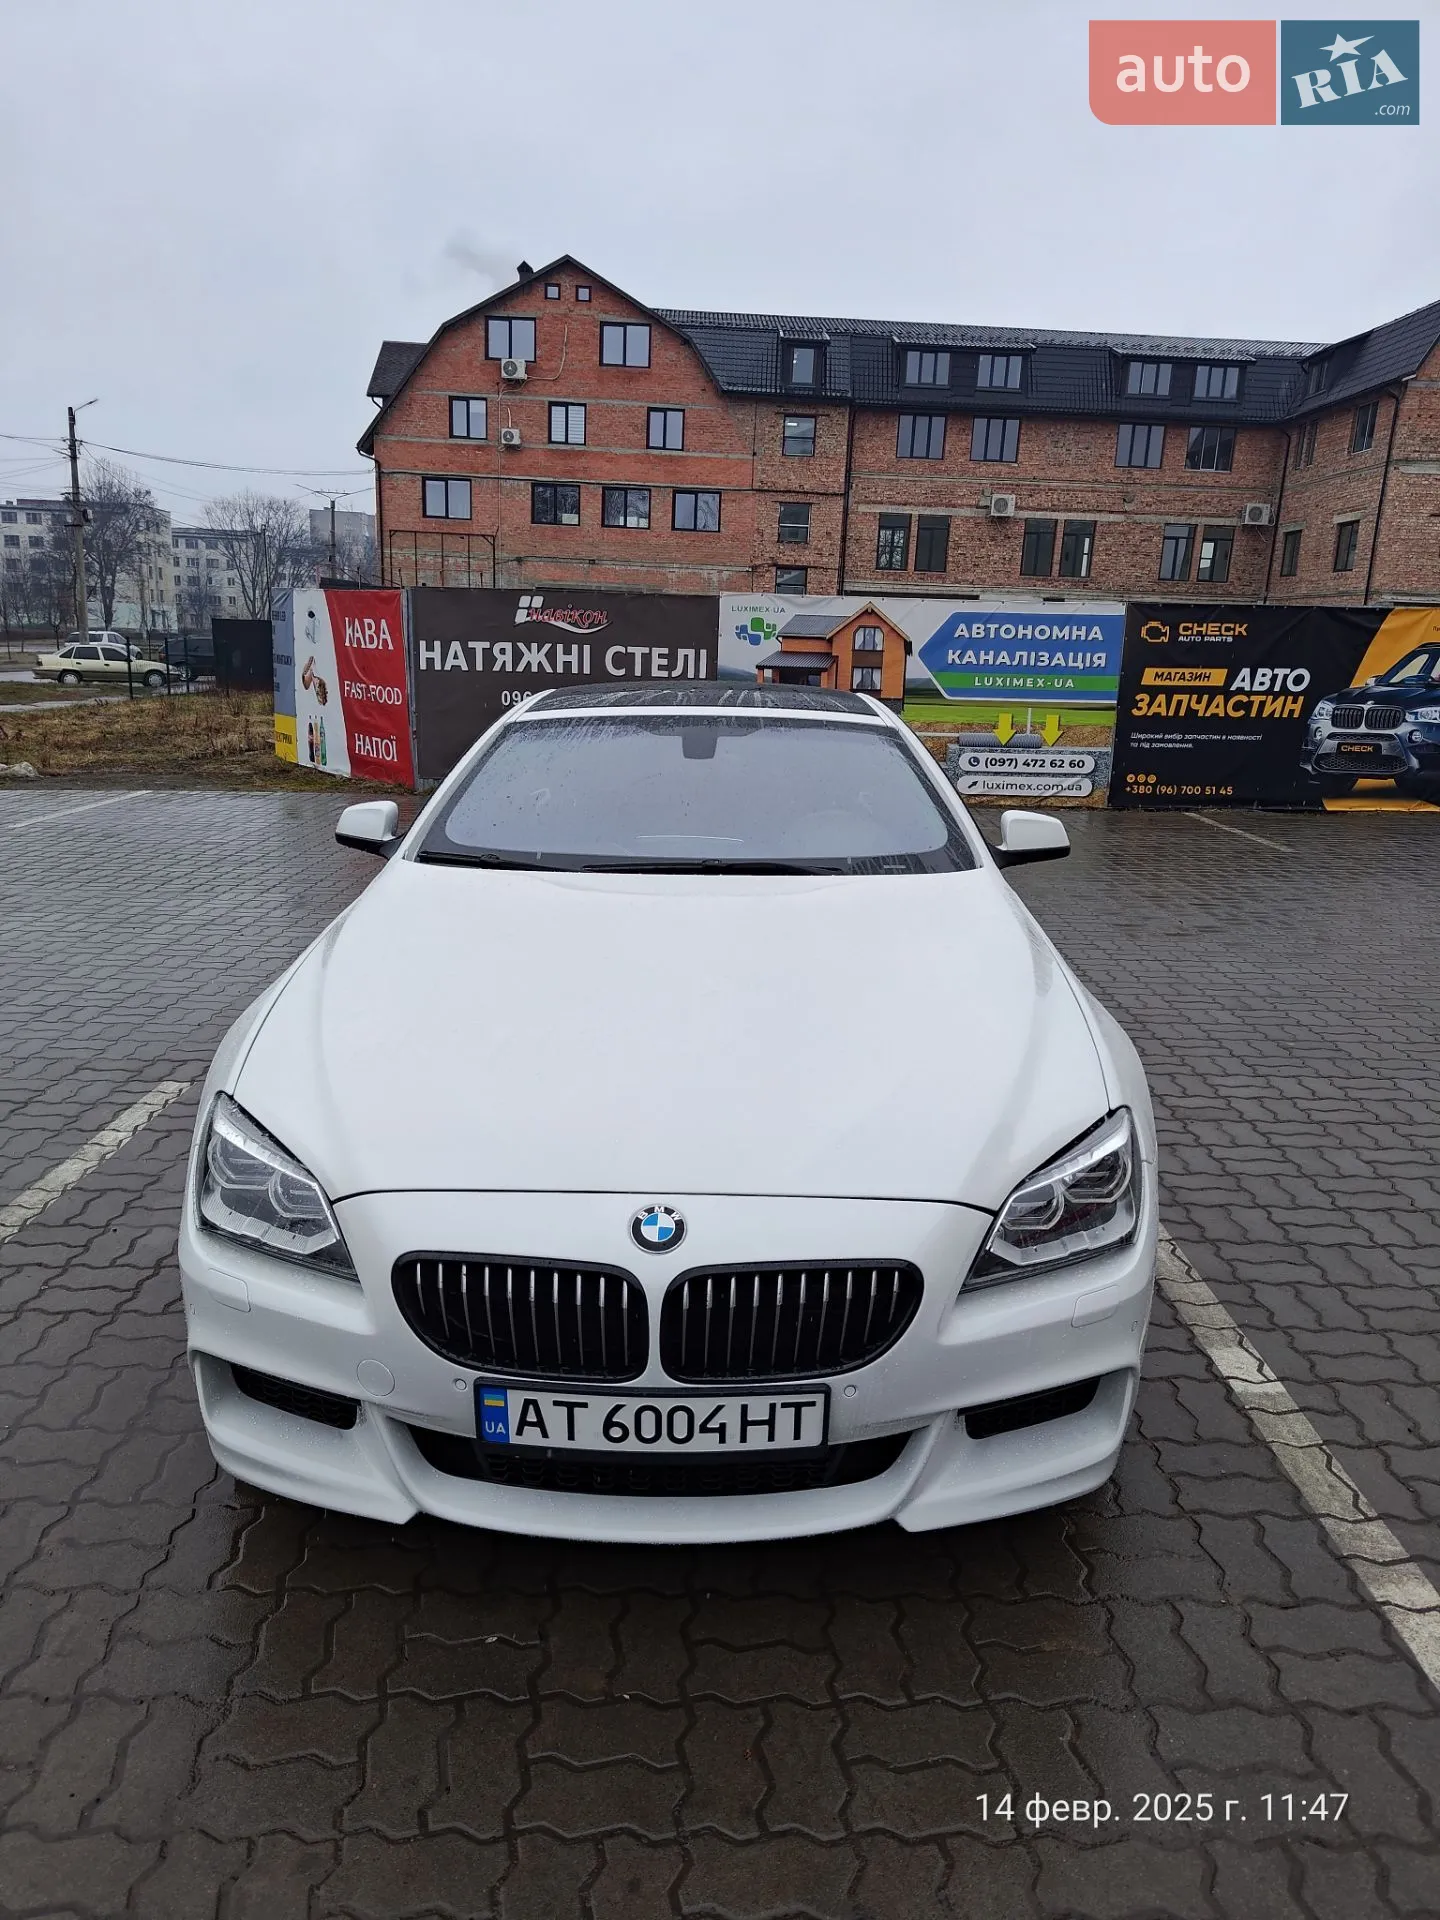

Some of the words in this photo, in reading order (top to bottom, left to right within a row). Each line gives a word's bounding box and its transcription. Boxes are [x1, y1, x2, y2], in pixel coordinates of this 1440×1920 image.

[344, 617, 394, 650] КАВА
[954, 622, 1103, 642] АВТОНОМНА
[1178, 622, 1249, 636] CHECK
[419, 639, 591, 675] НАТЯЖНІ
[604, 643, 707, 680] СТЕЛІ
[947, 649, 1107, 671] КАНАЛІЗАЦІЯ
[974, 675, 1075, 689] LUXIMEX-UA
[1153, 671, 1212, 683] МАГАЗИН
[1230, 667, 1311, 692] АВТО
[343, 680, 403, 705] FAST-FOOD
[1131, 694, 1304, 718] ЗАПЧАСТИН
[354, 733, 398, 762] НАПОЇ
[1341, 745, 1374, 753] CHECK
[984, 756, 1018, 770] (097)
[1022, 757, 1047, 769] 472
[1050, 757, 1065, 769] 62
[1067, 757, 1085, 769] 60
[982, 779, 1082, 793] luximex.com.ua
[1125, 785, 1153, 794] +380
[1156, 785, 1177, 795] (96)
[1181, 786, 1201, 795] 700
[1205, 786, 1216, 795] 51
[1219, 786, 1233, 795] 45
[638, 1205, 682, 1222] BMW
[485, 1420, 506, 1435] UA
